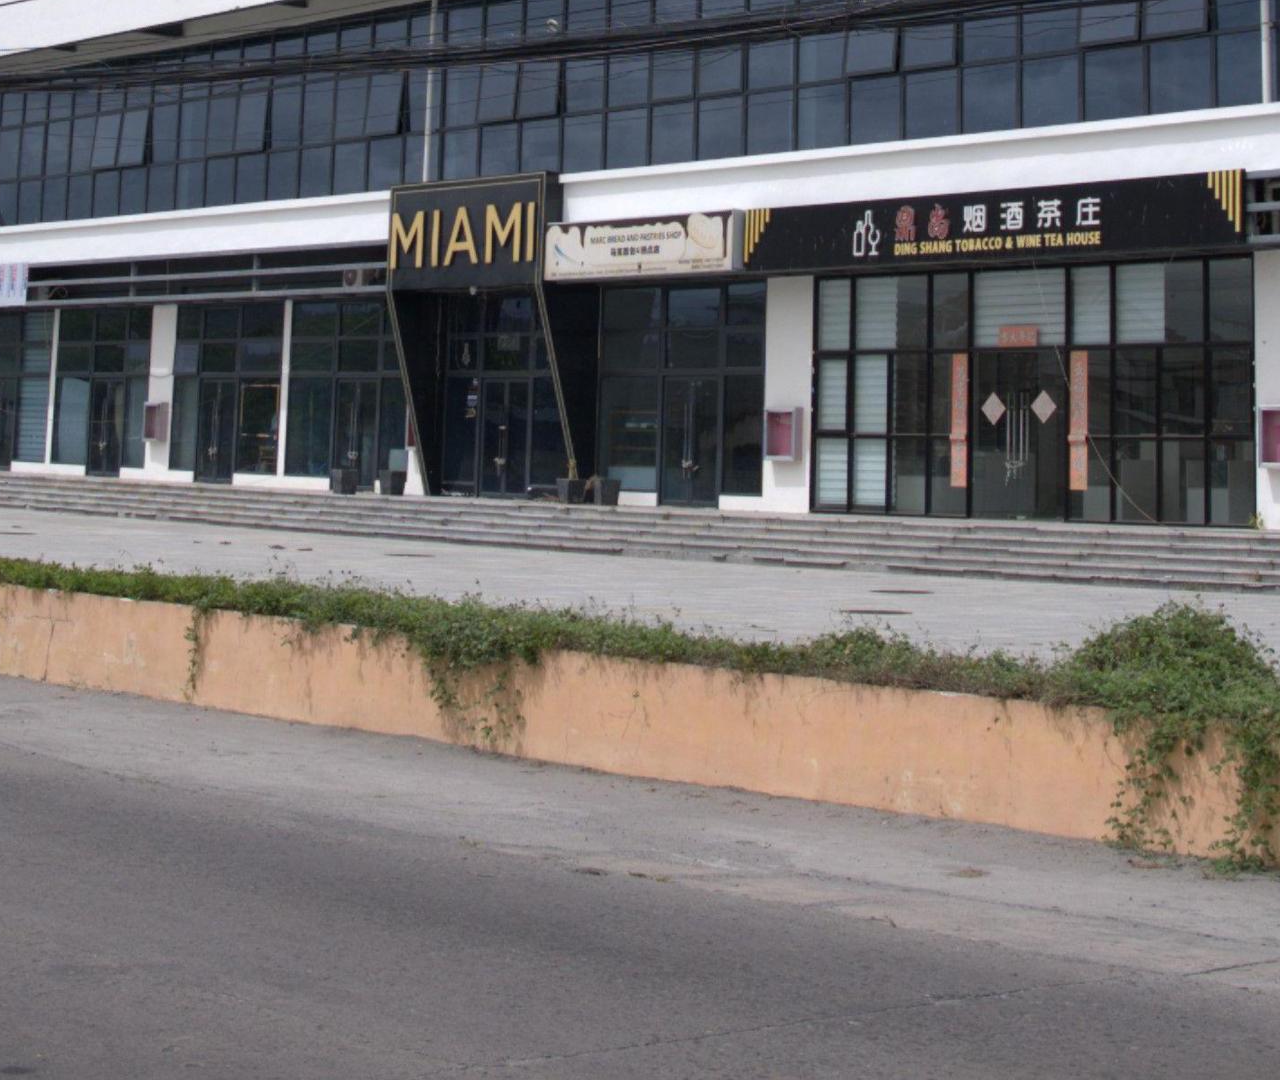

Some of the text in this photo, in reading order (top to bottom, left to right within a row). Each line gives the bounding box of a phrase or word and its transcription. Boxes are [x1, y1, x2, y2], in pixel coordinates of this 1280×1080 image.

[392, 201, 536, 269] MIAMI
[607, 234, 625, 243] BREAD
[626, 233, 639, 242] AND
[640, 231, 665, 241] PASTRIES
[666, 230, 682, 239] SHOP
[894, 231, 1102, 256] DING SHANG TOBACCO & WINE TEA HOUSE
